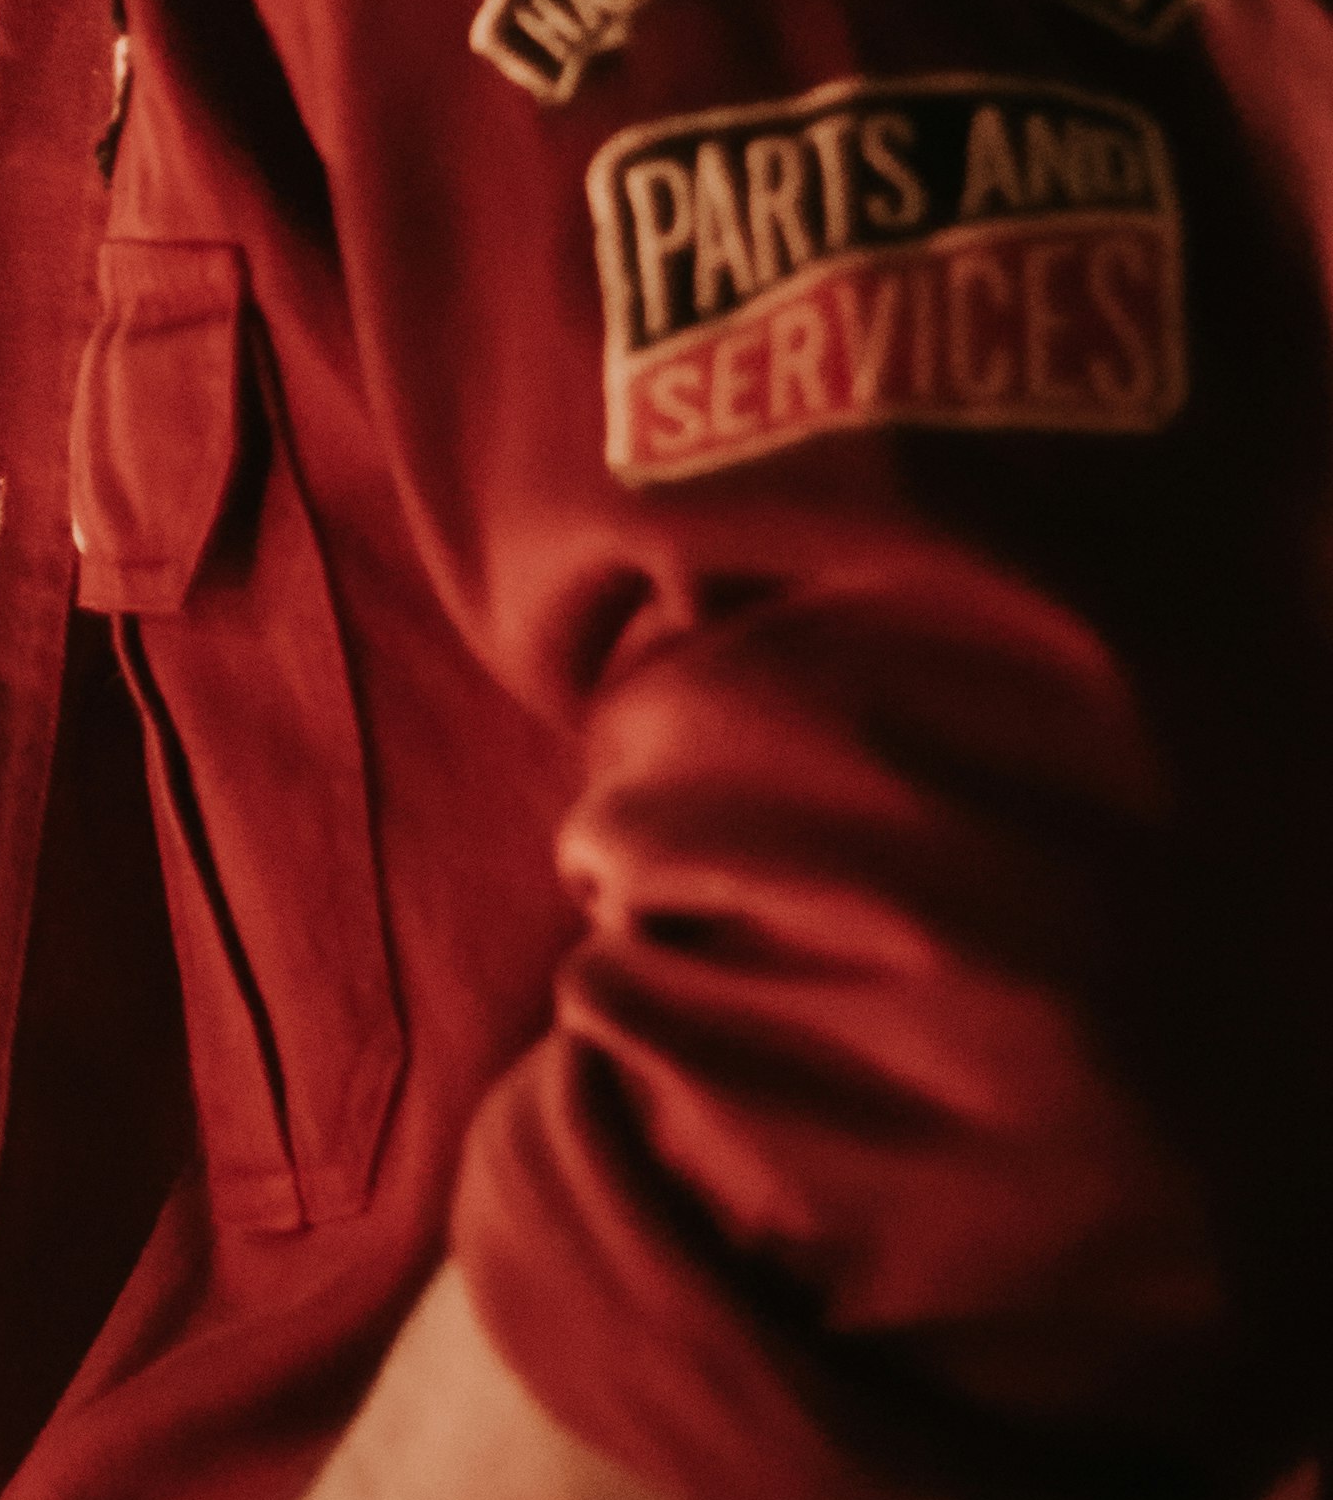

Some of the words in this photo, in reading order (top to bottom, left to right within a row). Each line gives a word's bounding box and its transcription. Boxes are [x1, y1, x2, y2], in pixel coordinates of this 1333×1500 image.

[625, 113, 925, 334] PARTS
[957, 102, 1146, 215] AND
[648, 238, 1155, 454] SERVICES
